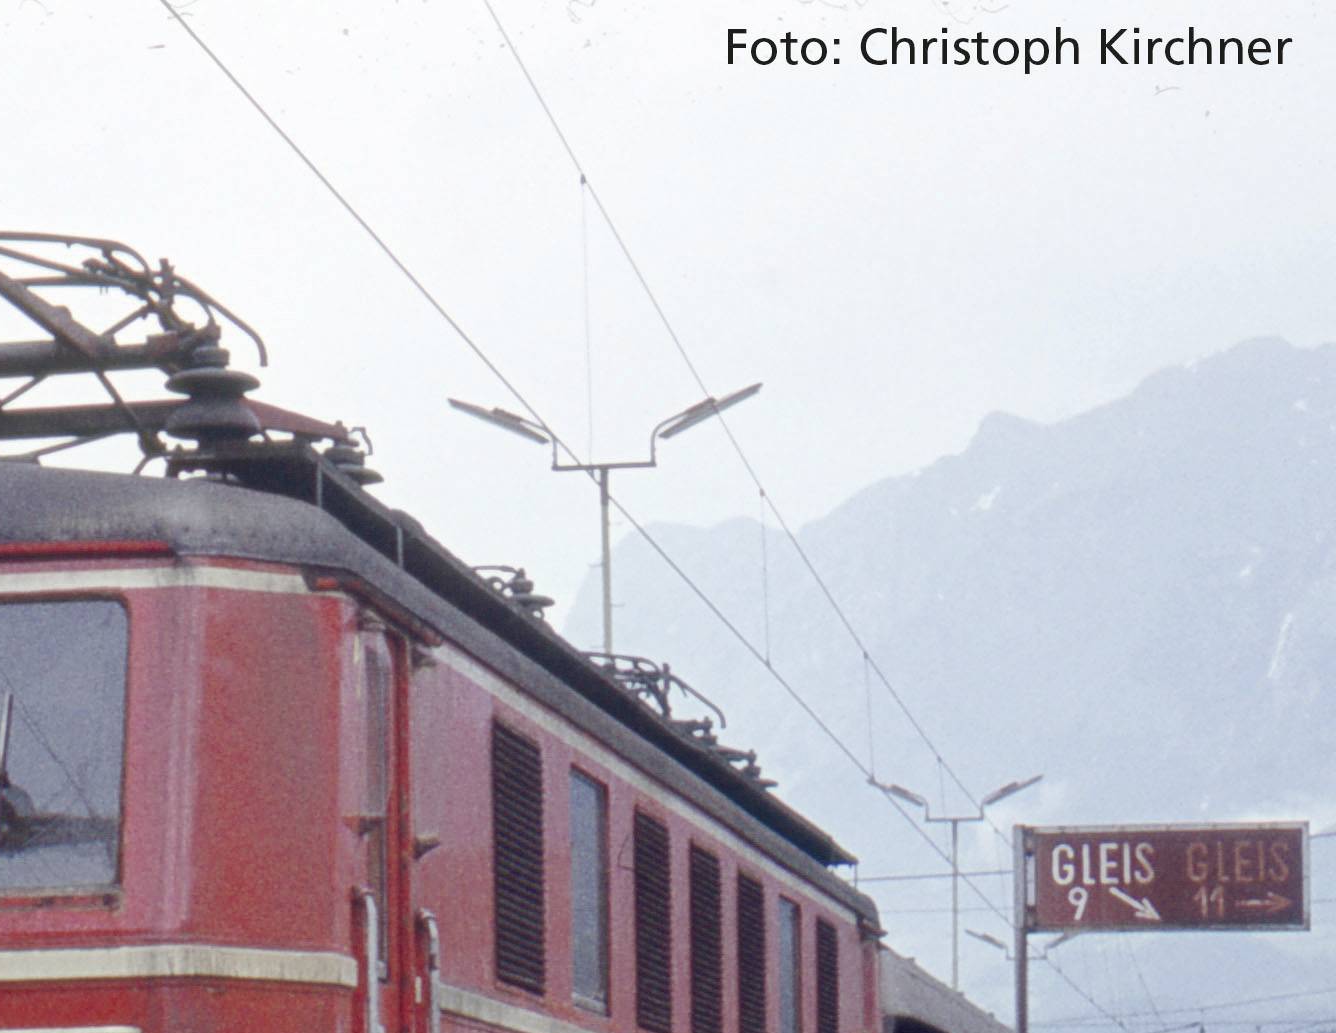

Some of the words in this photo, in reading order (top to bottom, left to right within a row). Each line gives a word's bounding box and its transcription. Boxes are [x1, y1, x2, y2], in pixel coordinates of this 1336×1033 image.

[1051, 841, 1155, 886] GLEIS
[1186, 839, 1290, 883] GLEIS
[1067, 886, 1089, 921] 9
[1193, 885, 1225, 918] 11
